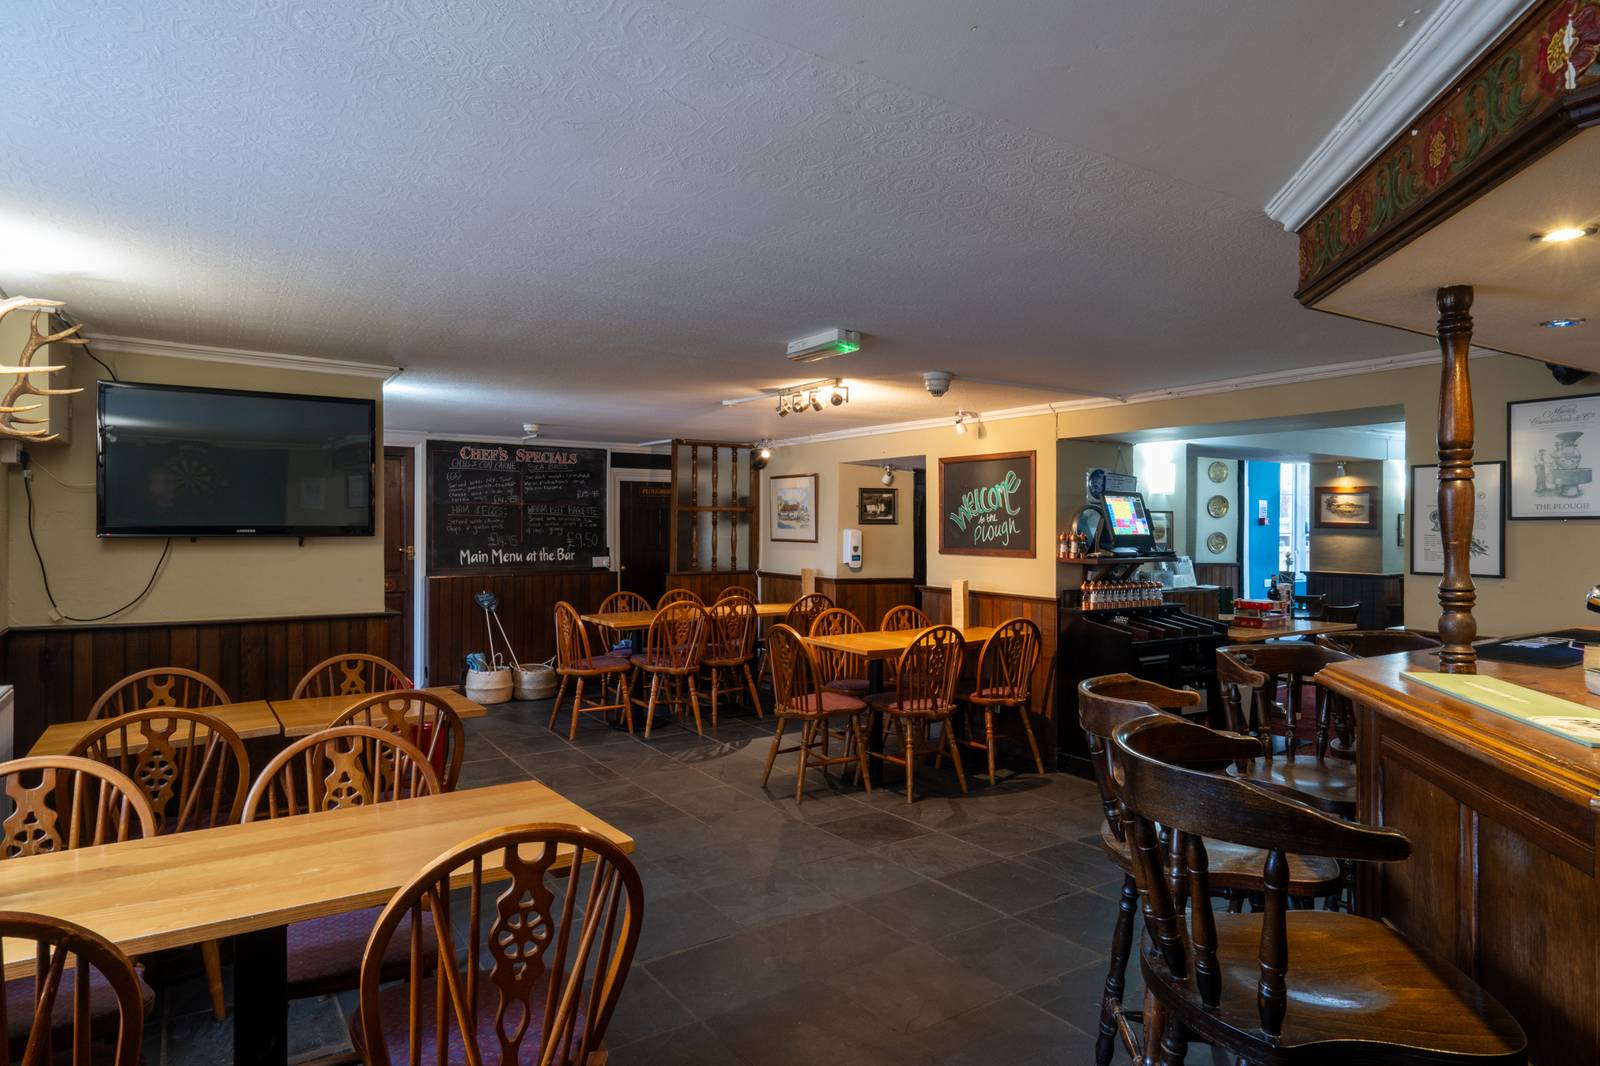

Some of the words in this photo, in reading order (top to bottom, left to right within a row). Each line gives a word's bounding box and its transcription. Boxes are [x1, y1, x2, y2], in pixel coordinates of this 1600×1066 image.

[1535, 503, 1552, 511] THE
[1553, 502, 1590, 511] PLOUGH
[460, 549, 489, 566] Main
[491, 549, 523, 565] Menu
[526, 551, 537, 562] at
[539, 547, 555, 561] the
[557, 547, 576, 561] Bar
